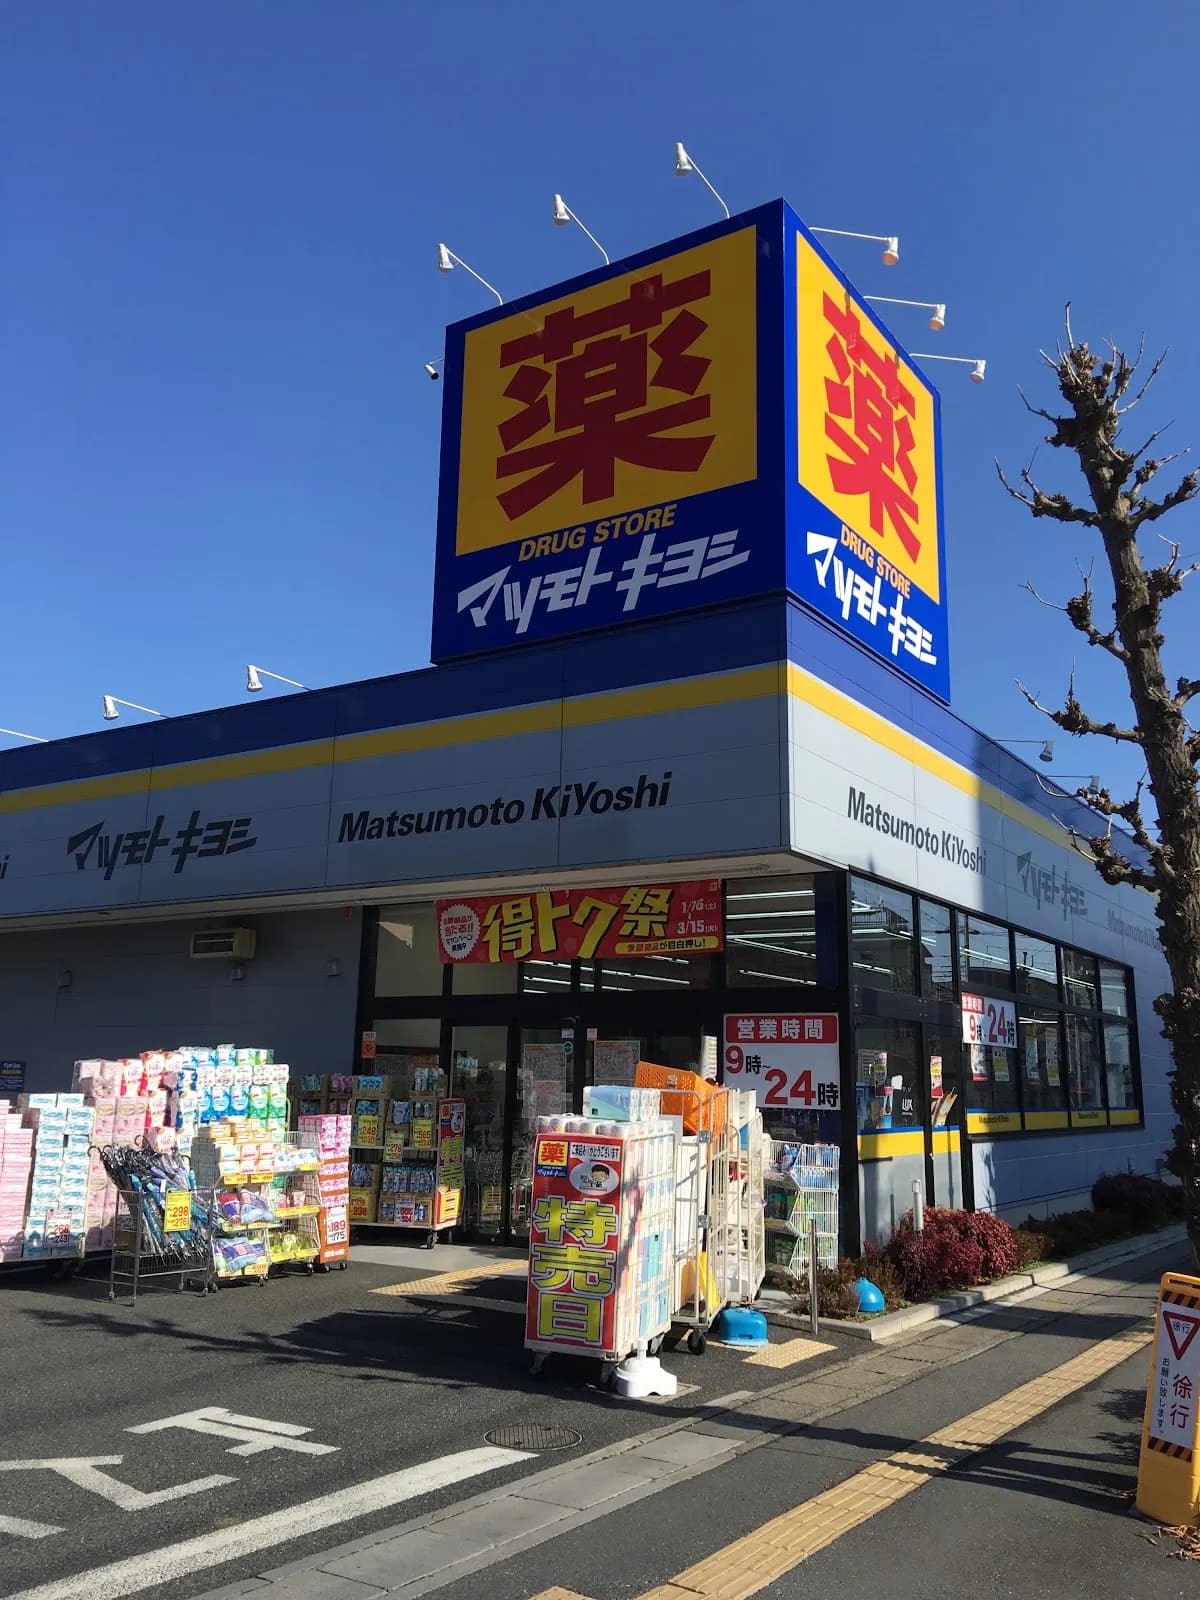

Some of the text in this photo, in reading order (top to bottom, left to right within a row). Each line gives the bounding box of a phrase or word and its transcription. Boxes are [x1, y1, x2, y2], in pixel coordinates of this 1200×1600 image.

[496, 269, 716, 521] 薬
[822, 290, 922, 564] 薬
[518, 503, 678, 561] DRUG STORE
[840, 524, 911, 600] DRUG STORE
[457, 529, 751, 634] マツモトキヨシ
[806, 530, 938, 666] マツモトキヨシ
[337, 771, 672, 844] Matsumoto KiYoshi
[847, 786, 987, 876] Matsumoto KiYoshi
[66, 810, 258, 880] マツモトキヨシ
[482, 887, 672, 963] 得トク祭
[736, 1018, 823, 1040] 営業時間
[764, 1068, 839, 1108] 24時
[541, 1142, 566, 1163] 薬
[173, 1206, 189, 1218] 298
[330, 1219, 346, 1232] 189
[533, 1196, 619, 1346] 特売日
[1169, 1373, 1193, 1430] 徐行
